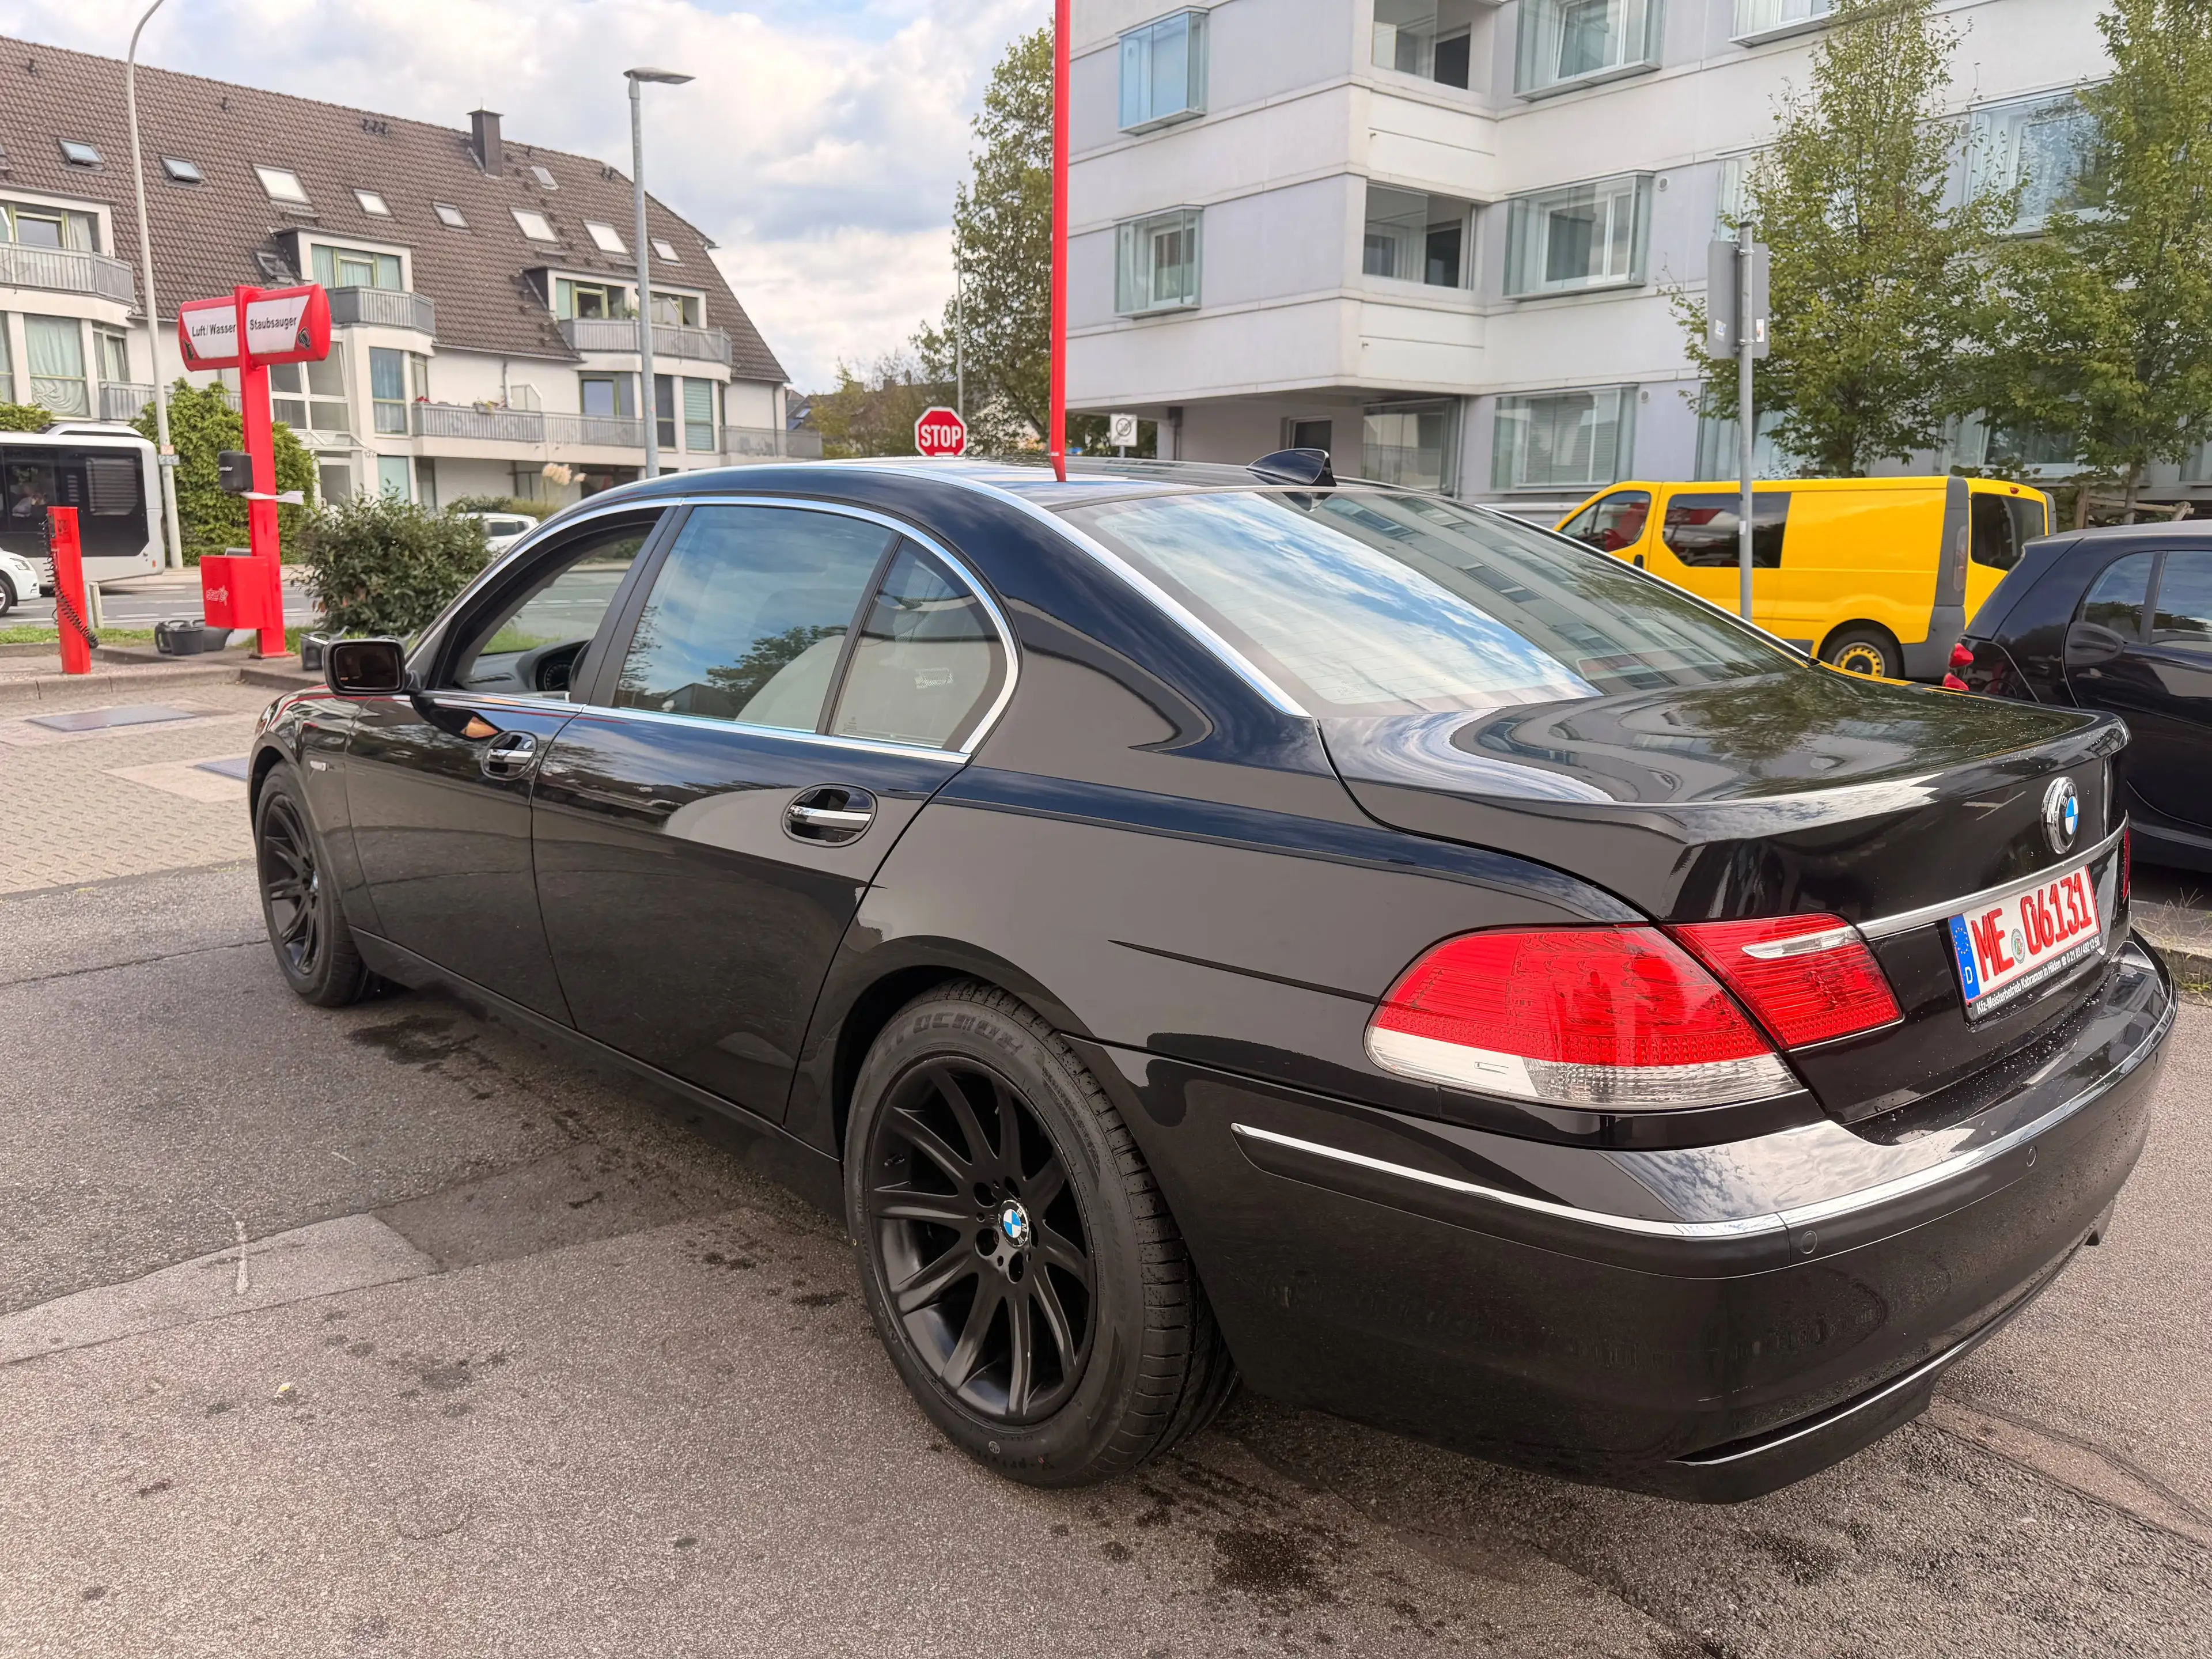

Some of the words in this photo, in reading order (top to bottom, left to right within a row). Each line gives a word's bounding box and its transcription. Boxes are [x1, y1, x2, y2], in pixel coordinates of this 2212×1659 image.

[249, 317, 297, 331] Staubsauger
[921, 424, 962, 448] STOP
[1970, 907, 2014, 983] ME
[2020, 872, 2092, 956] 06131
[1964, 966, 1974, 985] D
[1976, 981, 2022, 1014] Kfz-Meisterbetrieb
[2020, 969, 2044, 990] Kahraman
[2042, 966, 2048, 978] in
[2047, 960, 2062, 974] Hilden
